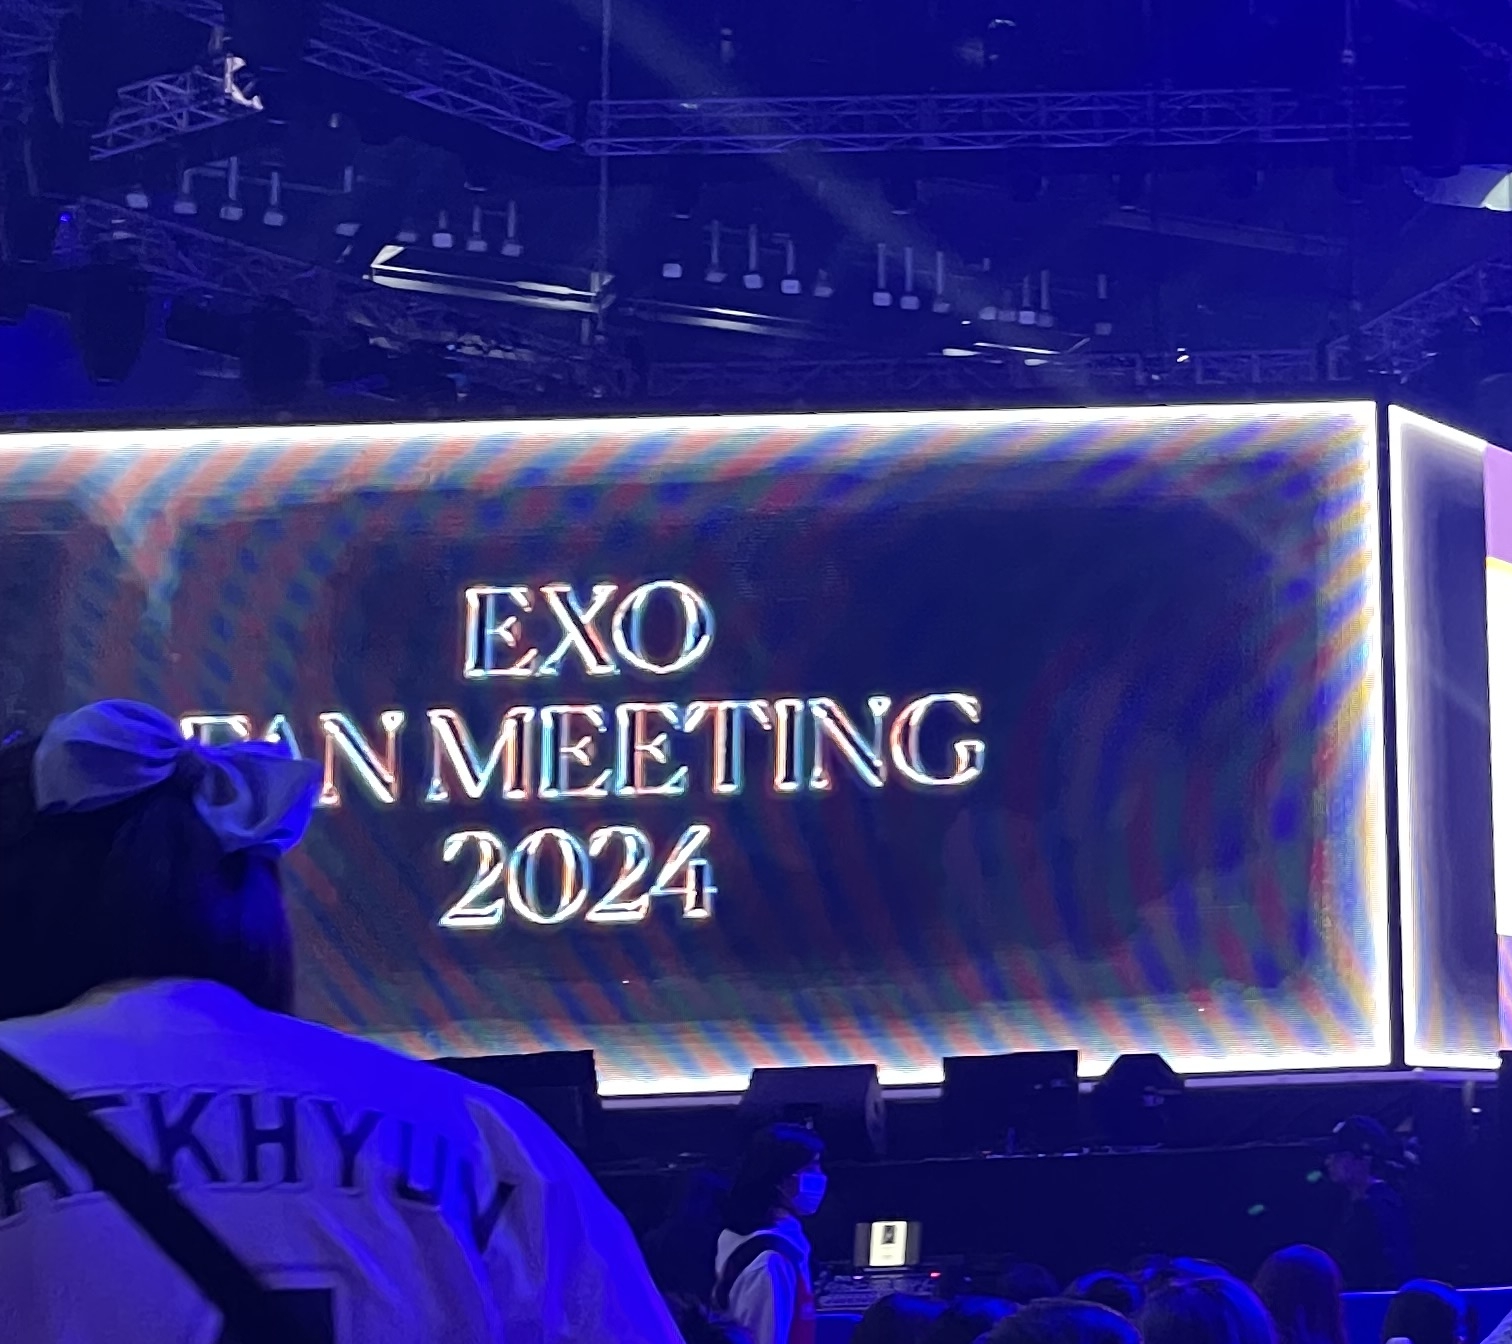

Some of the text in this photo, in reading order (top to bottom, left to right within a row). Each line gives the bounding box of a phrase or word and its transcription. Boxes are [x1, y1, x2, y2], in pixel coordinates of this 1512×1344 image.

[462, 578, 716, 678] EXO
[426, 692, 985, 801] MEETING
[439, 824, 717, 929] 2024
[0, 1091, 517, 1254] AKHYU
